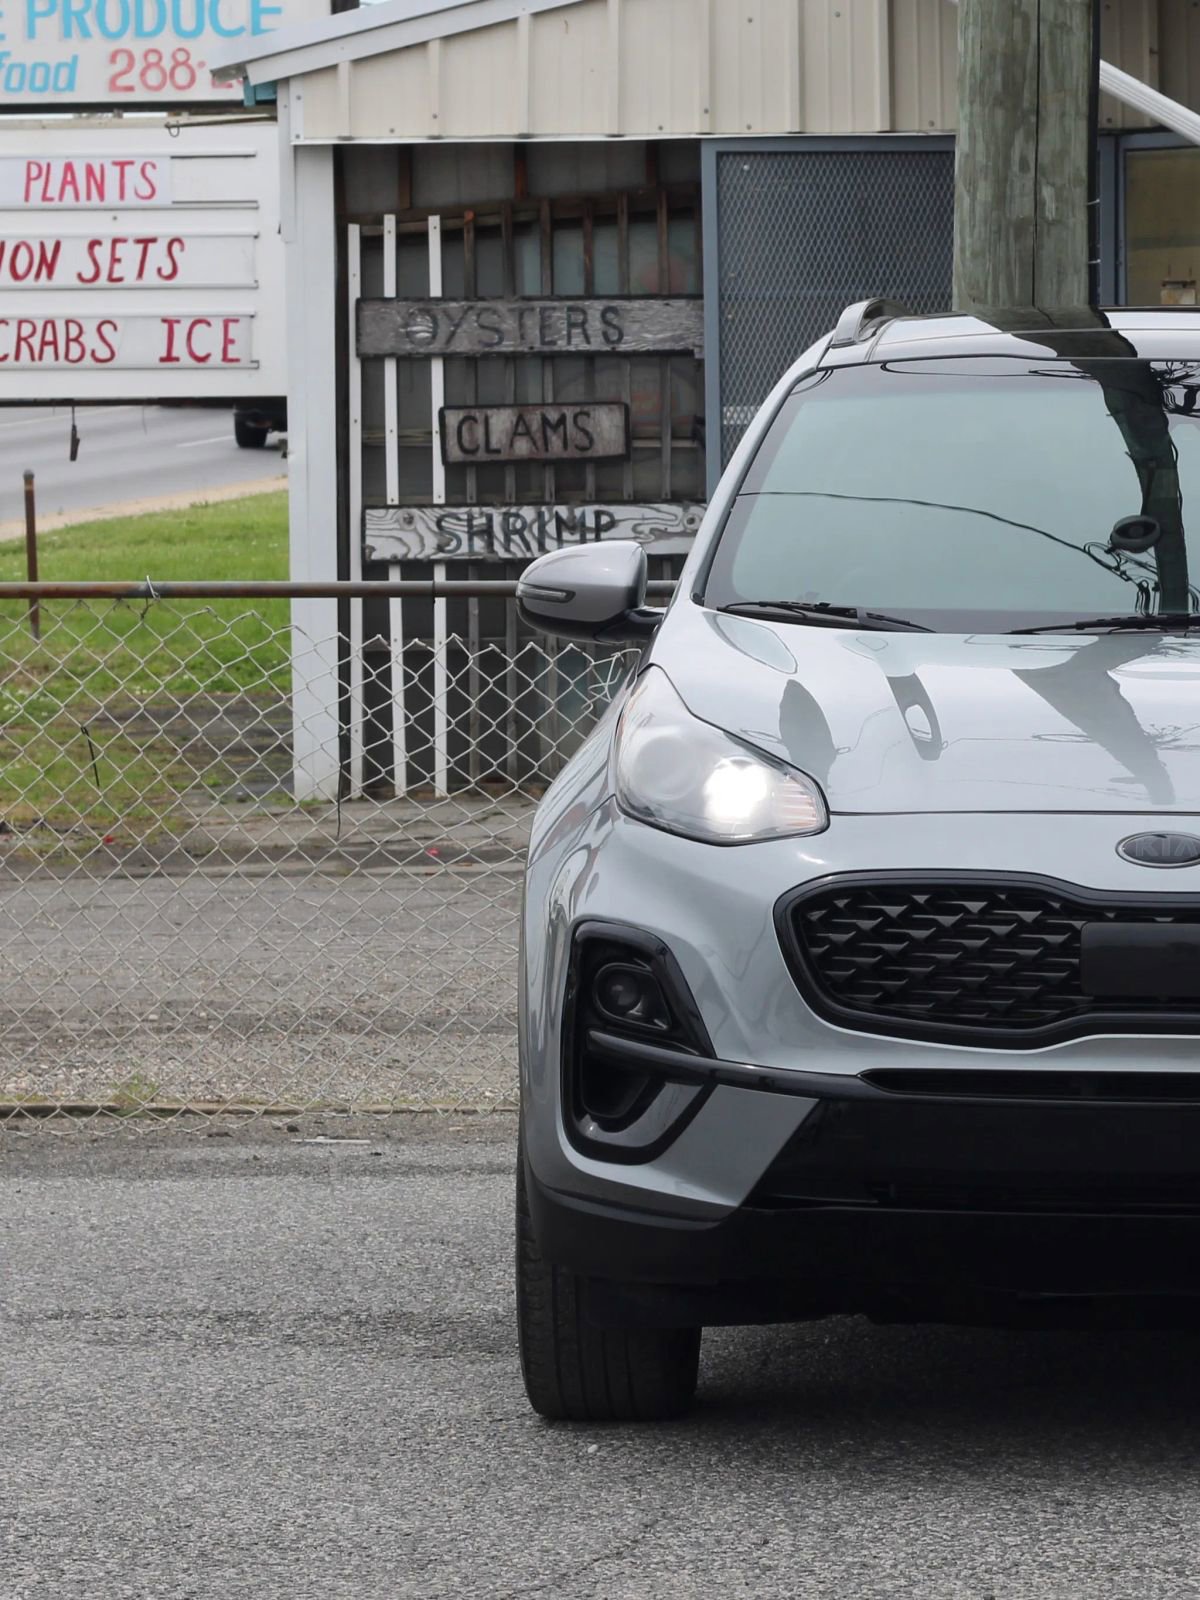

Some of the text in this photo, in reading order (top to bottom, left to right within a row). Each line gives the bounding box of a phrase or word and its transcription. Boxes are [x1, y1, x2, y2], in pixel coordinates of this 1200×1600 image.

[26, 0, 284, 38] PRODUCE
[24, 160, 157, 203] PLANTS
[77, 237, 185, 284] SETS
[158, 317, 241, 364] ICE
[404, 304, 625, 348] OYSTERS
[456, 411, 596, 455] CLAMS
[435, 509, 617, 554] SHRIMP
[1135, 838, 1199, 857] KIA
